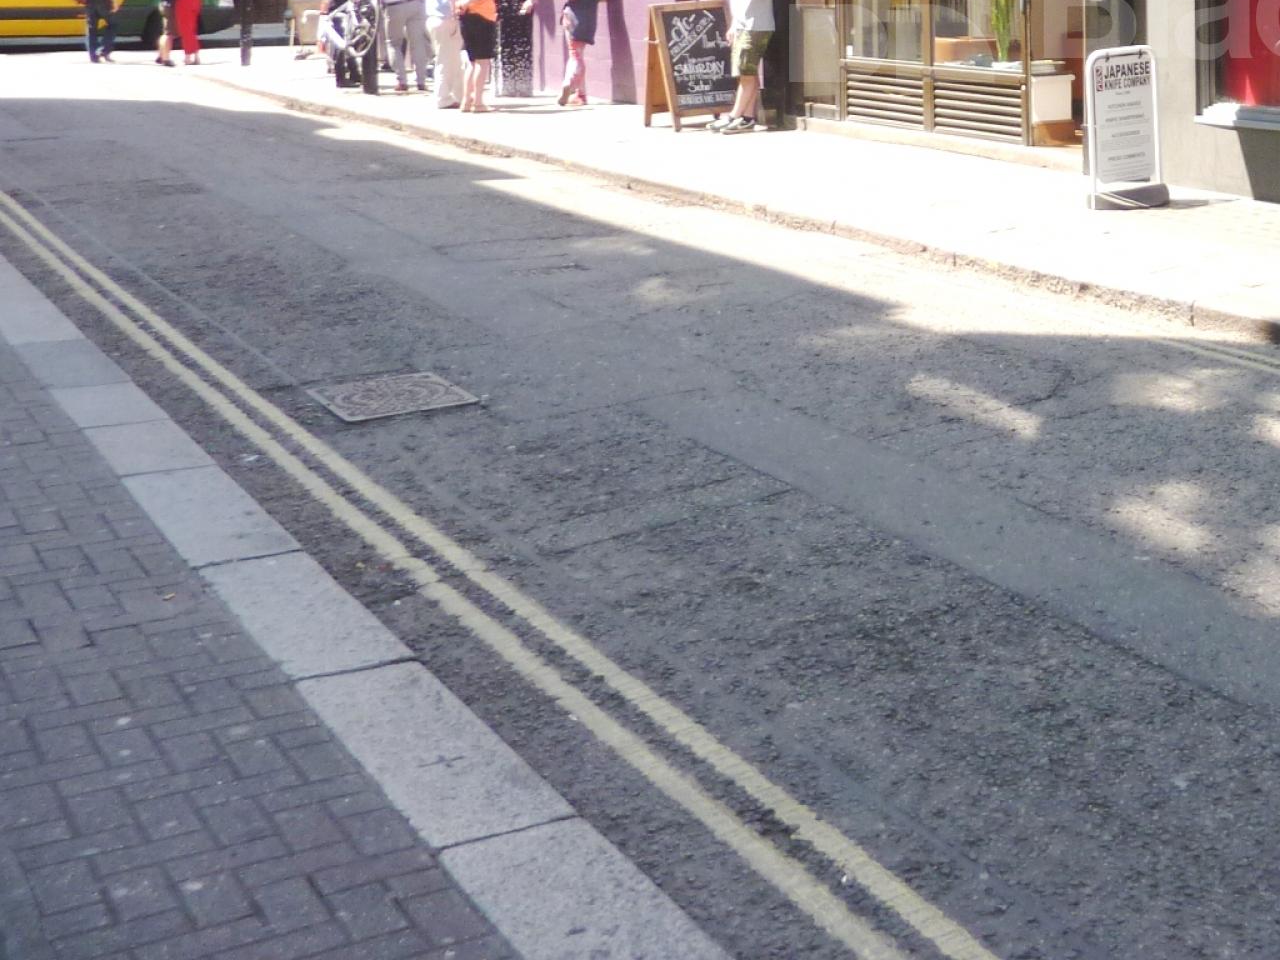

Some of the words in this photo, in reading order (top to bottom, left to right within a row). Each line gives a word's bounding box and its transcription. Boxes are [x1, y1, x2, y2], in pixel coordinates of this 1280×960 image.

[1104, 61, 1151, 80] JAPANESE
[1104, 78, 1122, 91] KNIFE
[1123, 75, 1151, 89] COMPANY
